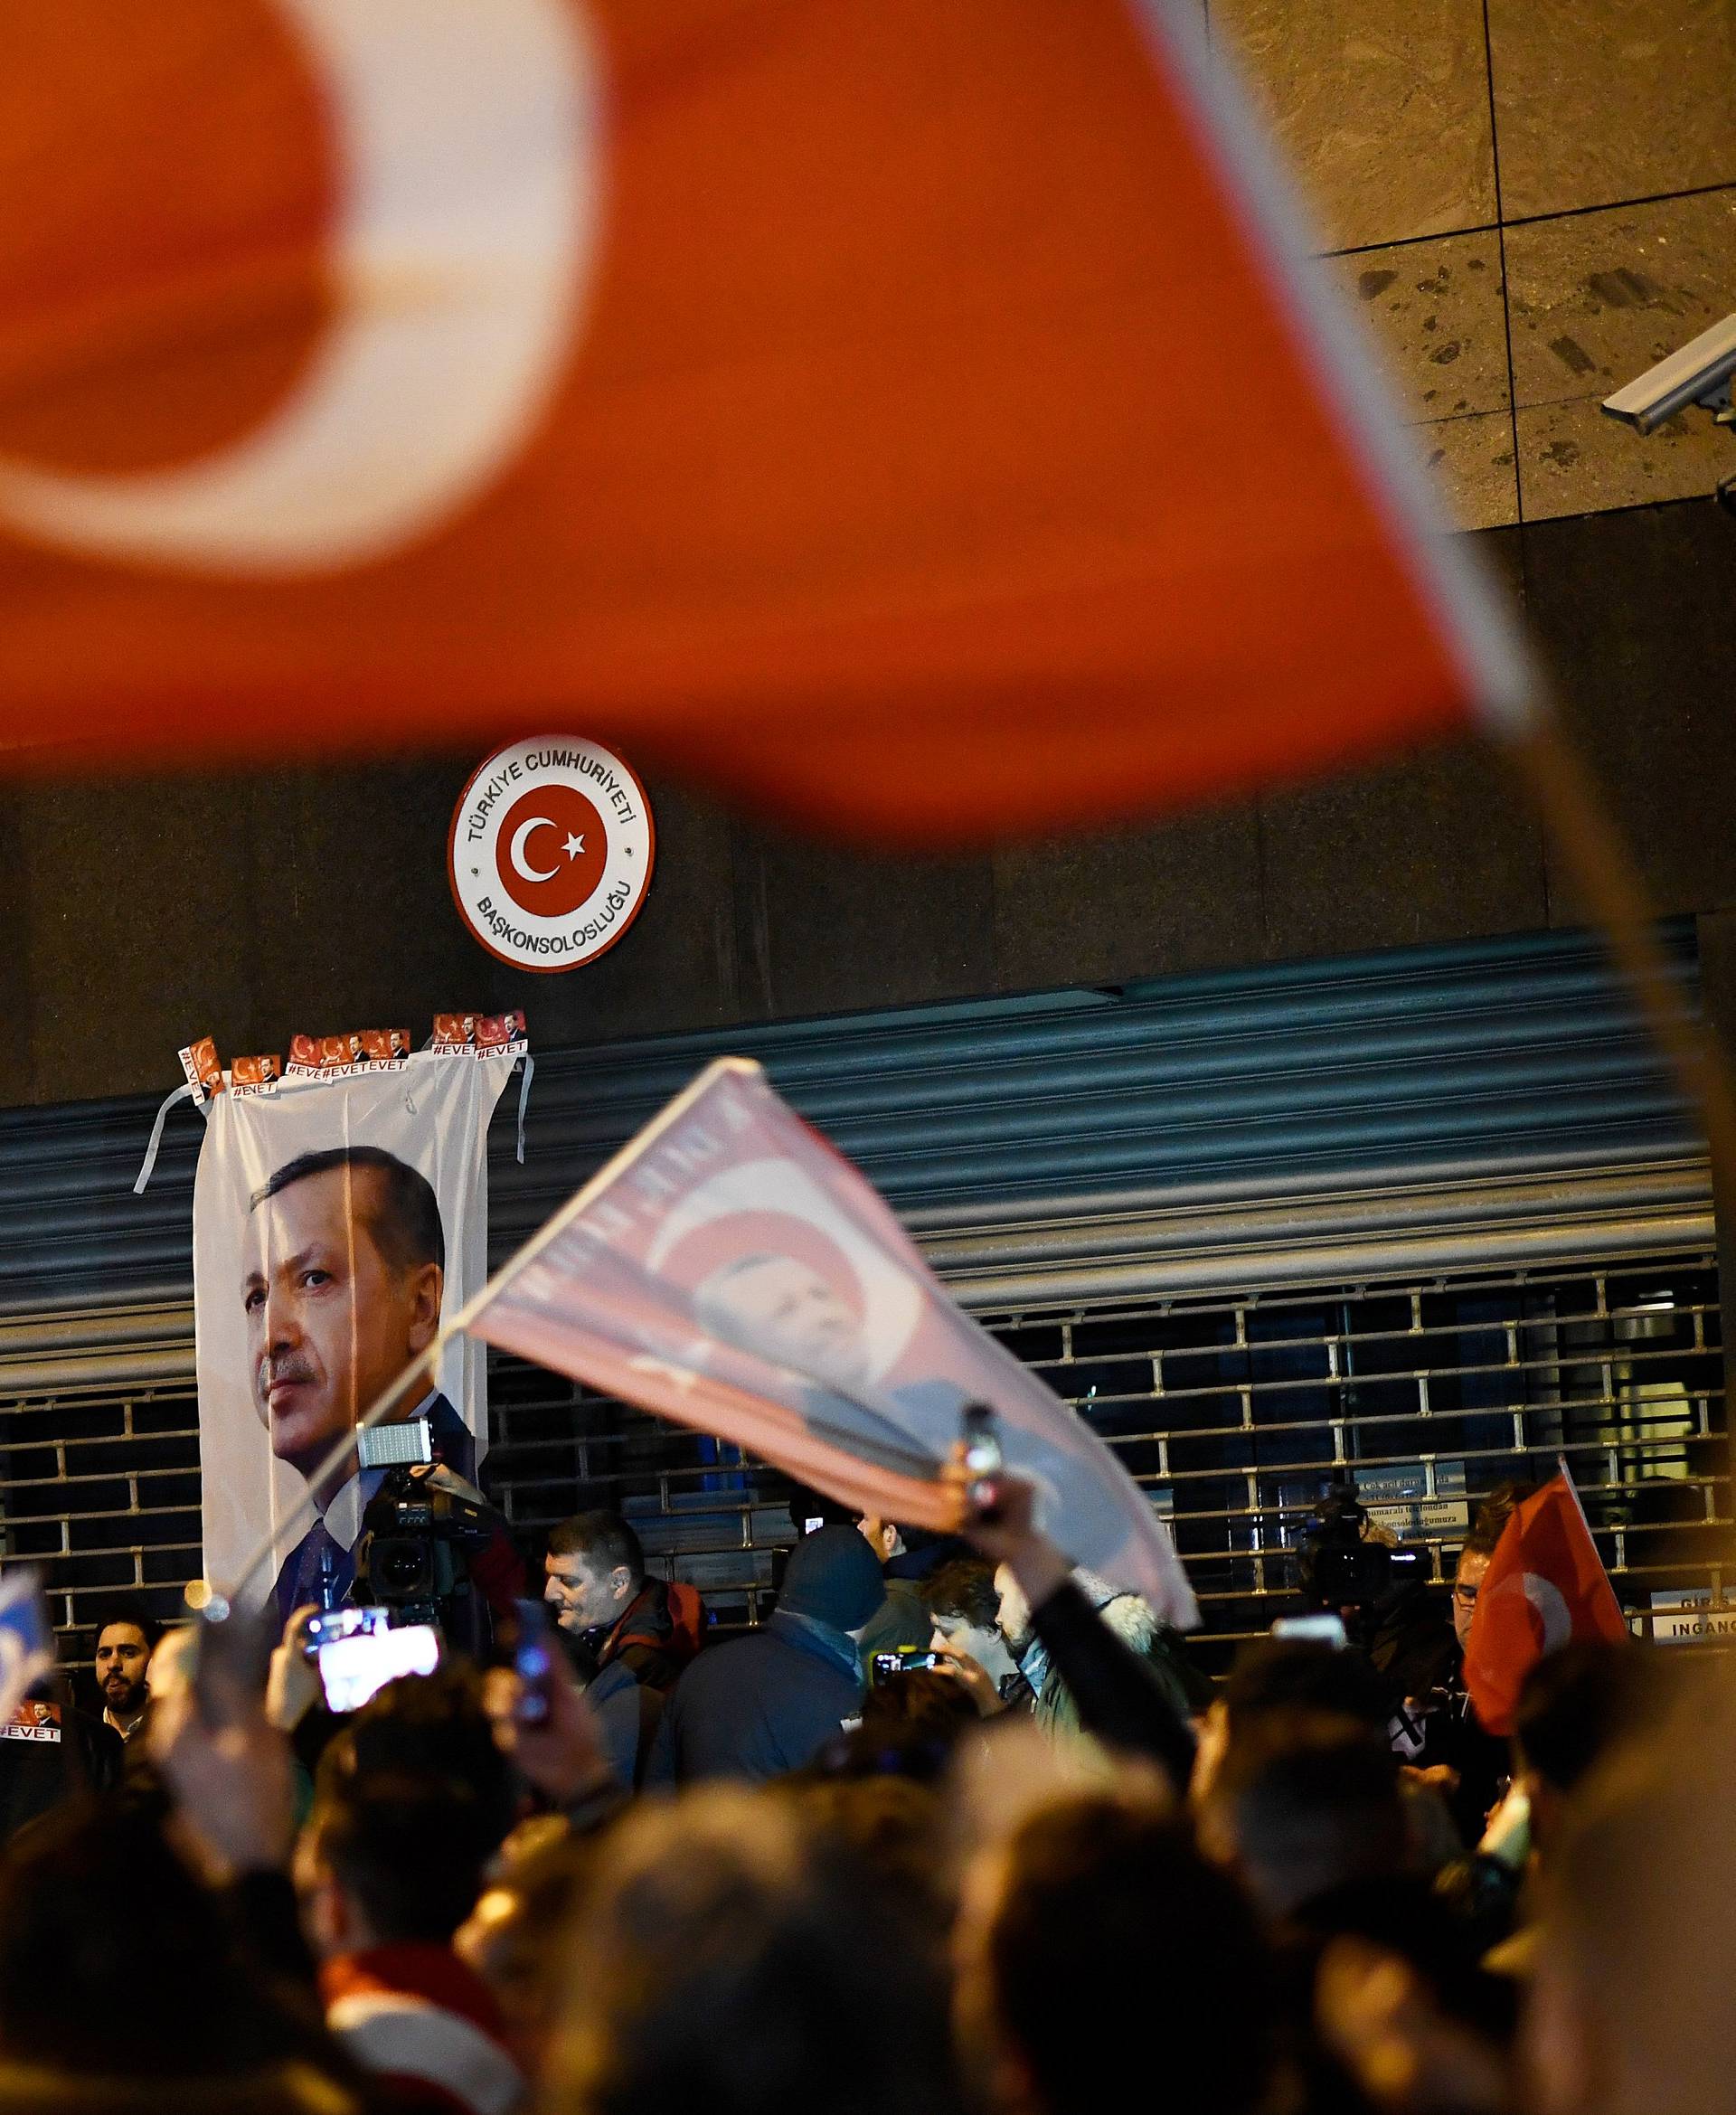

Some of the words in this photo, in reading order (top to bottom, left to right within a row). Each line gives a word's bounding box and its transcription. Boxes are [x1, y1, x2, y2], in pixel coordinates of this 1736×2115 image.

[467, 761, 523, 843] TÜRKİYE
[525, 750, 637, 825] CUMHURİYETİ
[476, 881, 631, 954] BAŞKONSOLOSLUĞU
[477, 1041, 525, 1060] #EVET
[182, 1050, 203, 1100] #EVET
[288, 1064, 324, 1081] #EVE
[322, 1062, 368, 1079] #EVET
[369, 1060, 406, 1071] EVET
